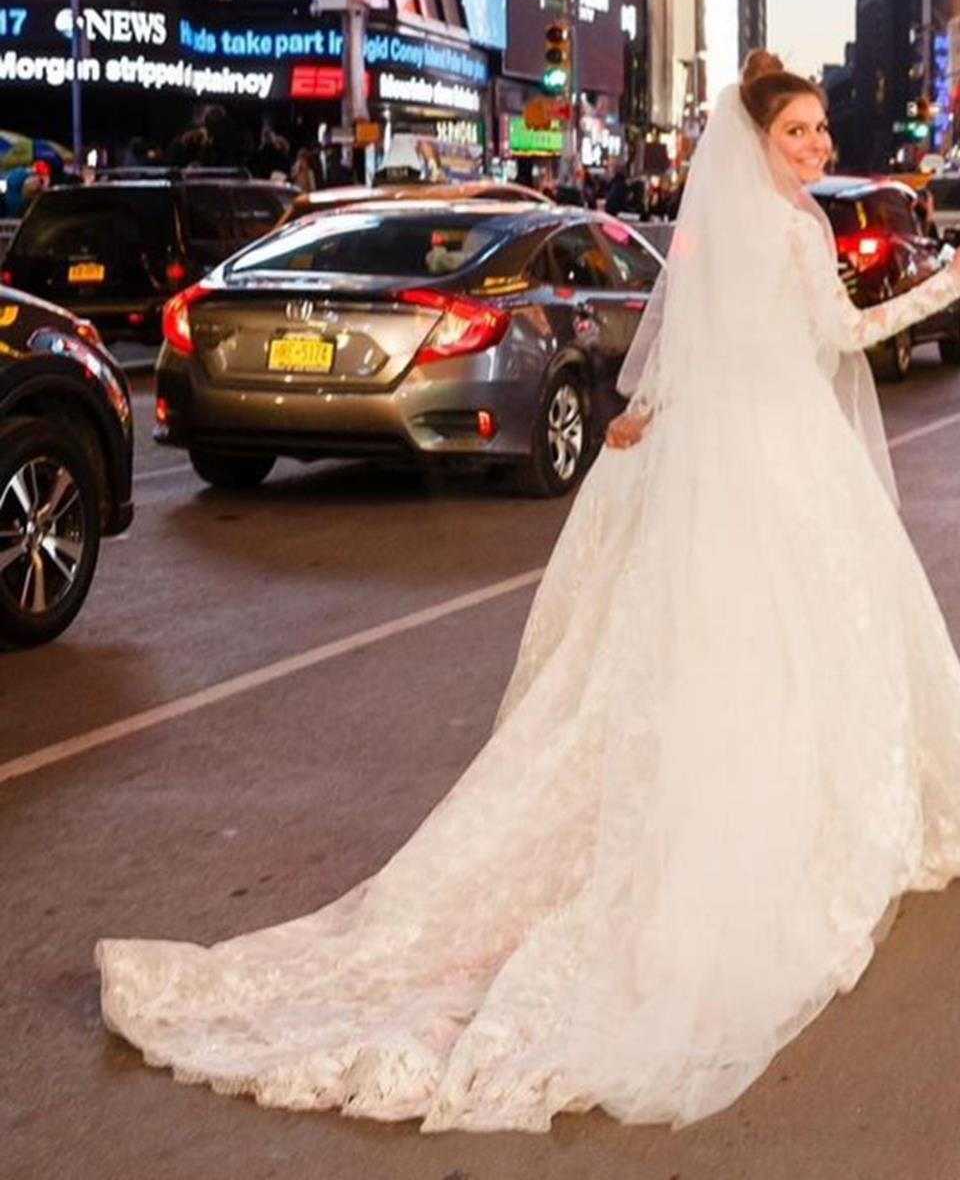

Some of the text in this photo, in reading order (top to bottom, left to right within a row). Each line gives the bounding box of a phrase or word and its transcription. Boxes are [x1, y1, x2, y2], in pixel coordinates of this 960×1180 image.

[83, 8, 167, 45] NEWS
[221, 29, 272, 55] take
[275, 30, 325, 59] part
